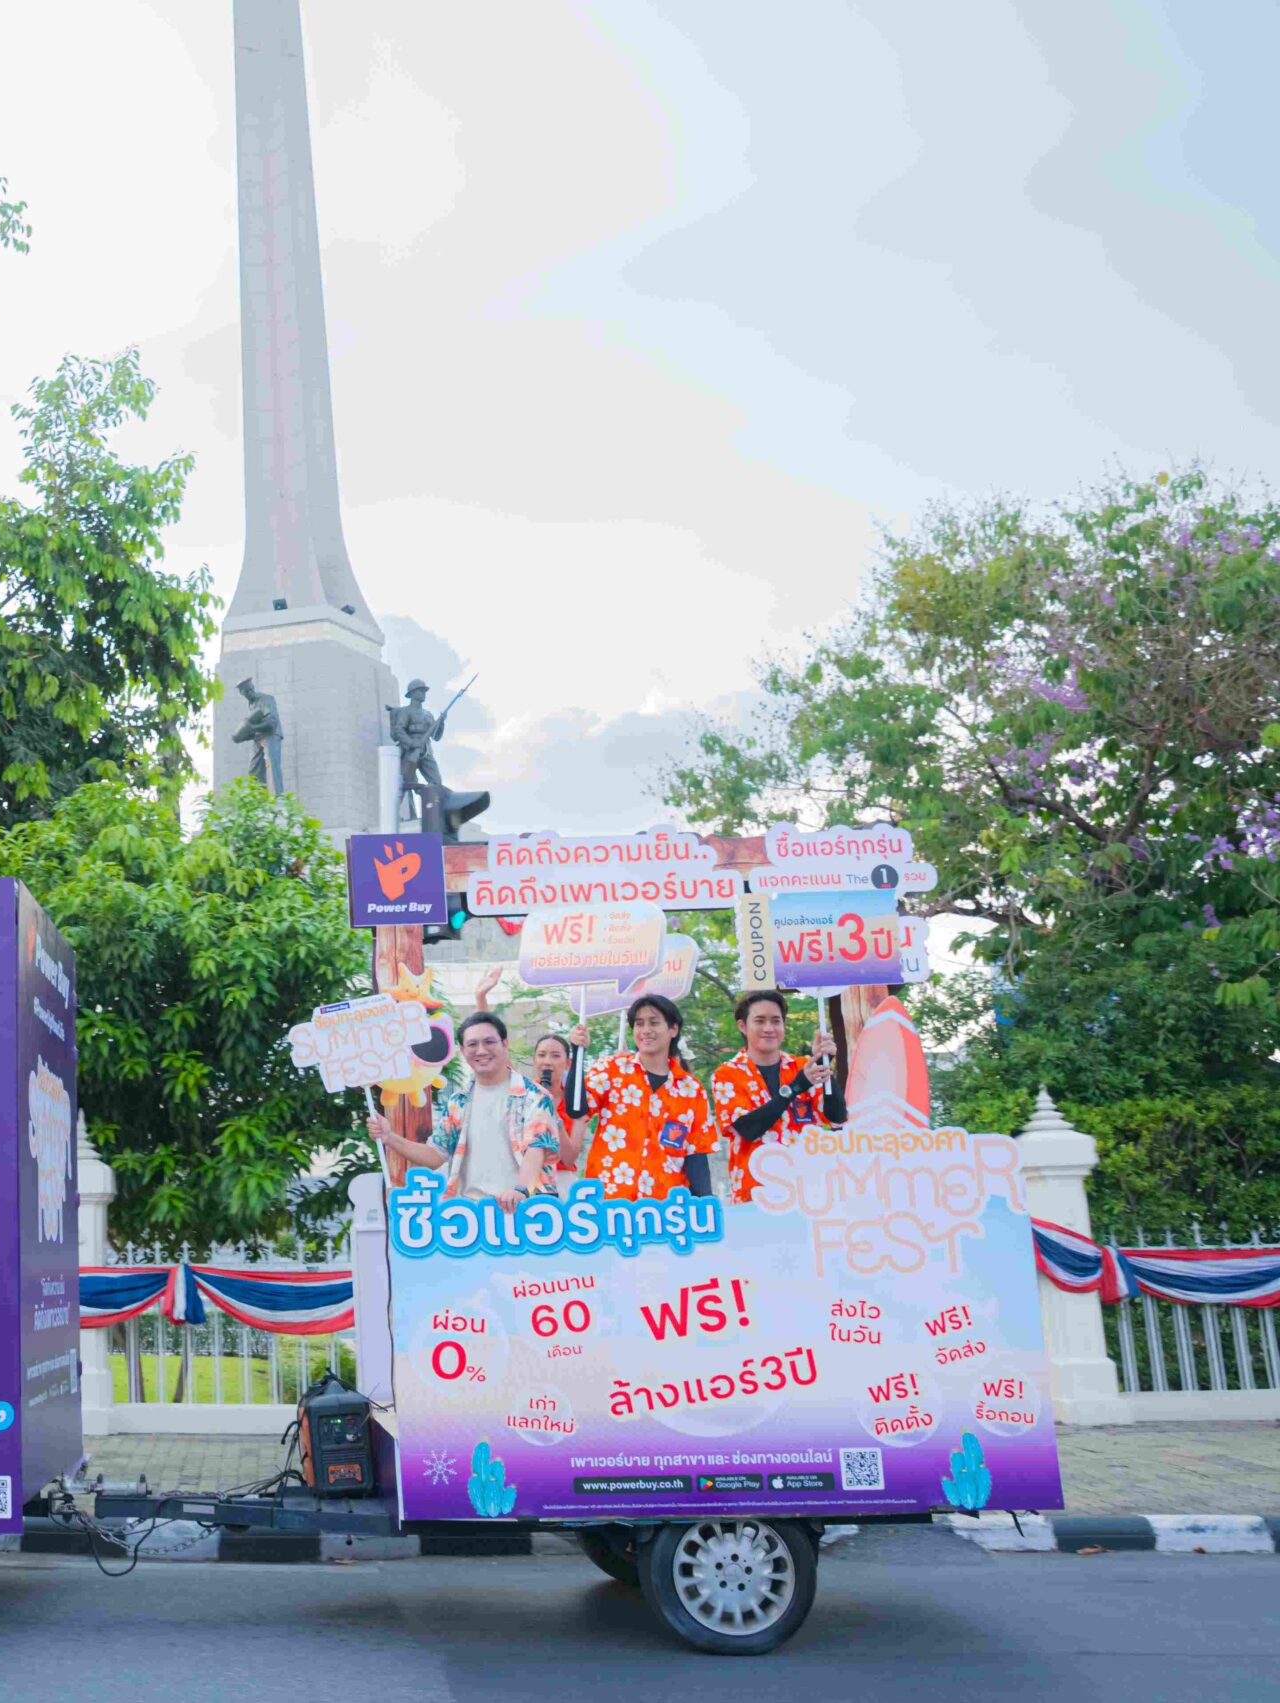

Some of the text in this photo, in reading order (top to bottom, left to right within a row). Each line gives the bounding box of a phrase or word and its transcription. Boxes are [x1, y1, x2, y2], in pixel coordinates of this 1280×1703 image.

[476, 872, 734, 906] คิดถึงเพาเวอร์บาย
[846, 874, 869, 885] The
[367, 902, 432, 913] Power Buy
[544, 913, 594, 944] ฟรี!
[774, 914, 834, 928] คูปองล้างแอร์
[749, 902, 767, 981] COUPON
[513, 1275, 595, 1298] ผ่อนนาน
[531, 1299, 591, 1337] 60
[831, 1298, 881, 1320] ส่งไว
[433, 1309, 486, 1333] ผ่อน
[924, 1305, 972, 1337] ฟรี!
[829, 1323, 881, 1345] ในวัน
[432, 1340, 486, 1382] 0%
[935, 1339, 986, 1365] จัดส่ง
[609, 1346, 818, 1416] ล้างแอร์3ปี
[867, 1372, 919, 1404] ฟรี!
[983, 1378, 1024, 1399] ฟรี!
[529, 1395, 556, 1411] เก่า
[507, 1415, 574, 1434] แลกใหม่
[874, 1405, 933, 1435] ติดตั้ง
[571, 1453, 650, 1468] เพาเวอร์บาย
[732, 1448, 832, 1466] ช่องทางออนไลน์
[583, 1479, 684, 1492] www.powerbuy.co.th
[715, 1480, 760, 1489] Google Play
[786, 1479, 824, 1488] App Store
